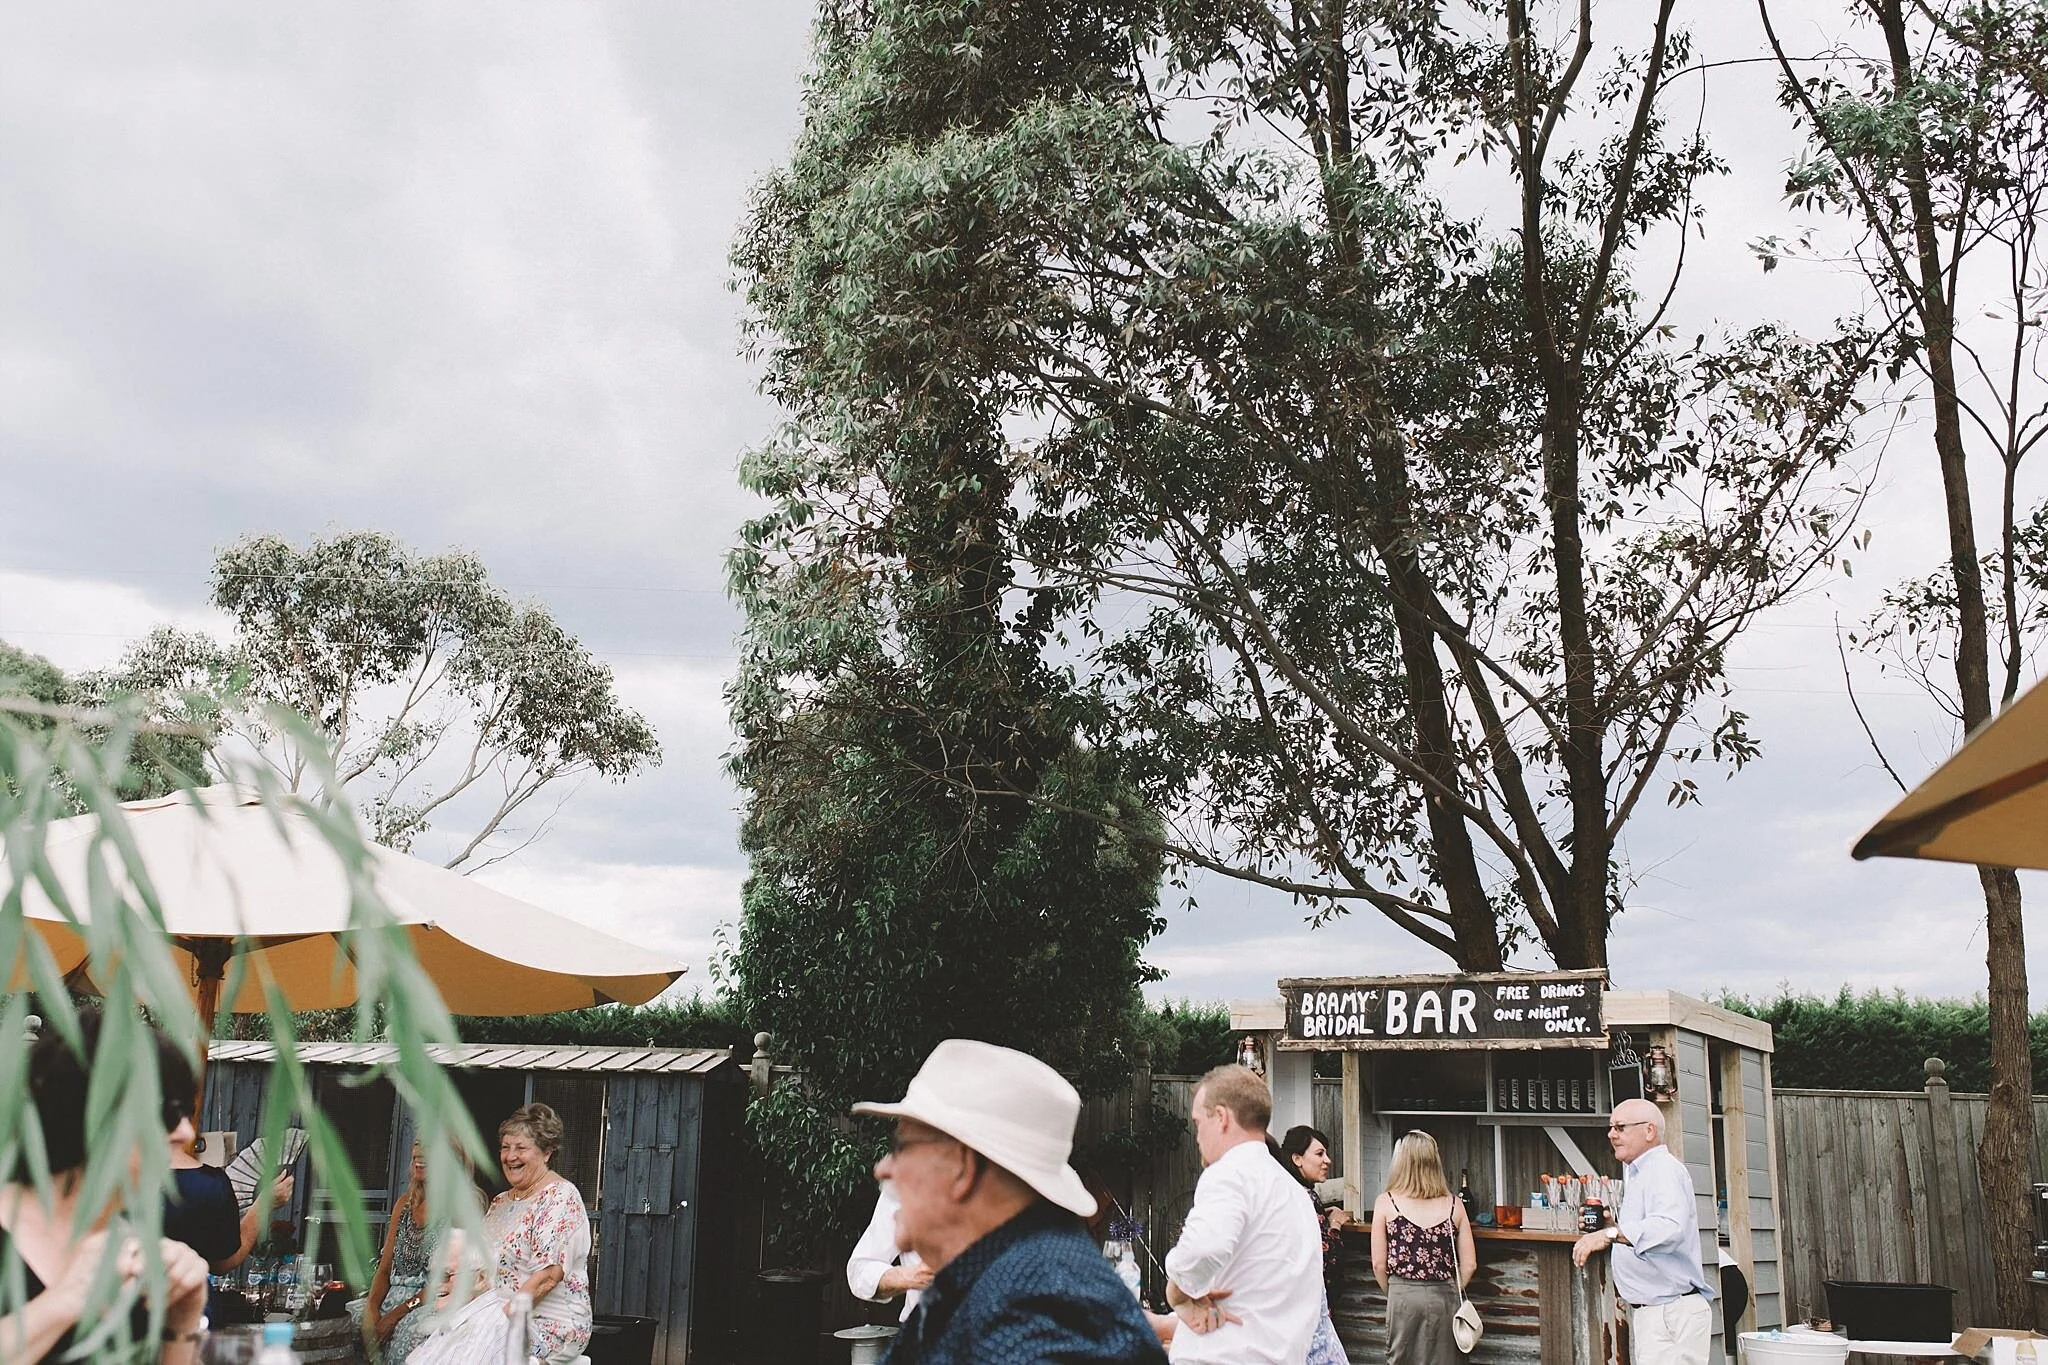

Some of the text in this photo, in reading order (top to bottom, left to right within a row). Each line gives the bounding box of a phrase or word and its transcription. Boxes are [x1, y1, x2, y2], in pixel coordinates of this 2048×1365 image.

[1496, 984, 1585, 1001] FREE DRINKS
[1385, 988, 1478, 1035] BAR
[1493, 1004, 1569, 1021] ONE NIGHT
[1303, 1014, 1375, 1037] BRIDAL
[1544, 1016, 1591, 1033] ONLY.
